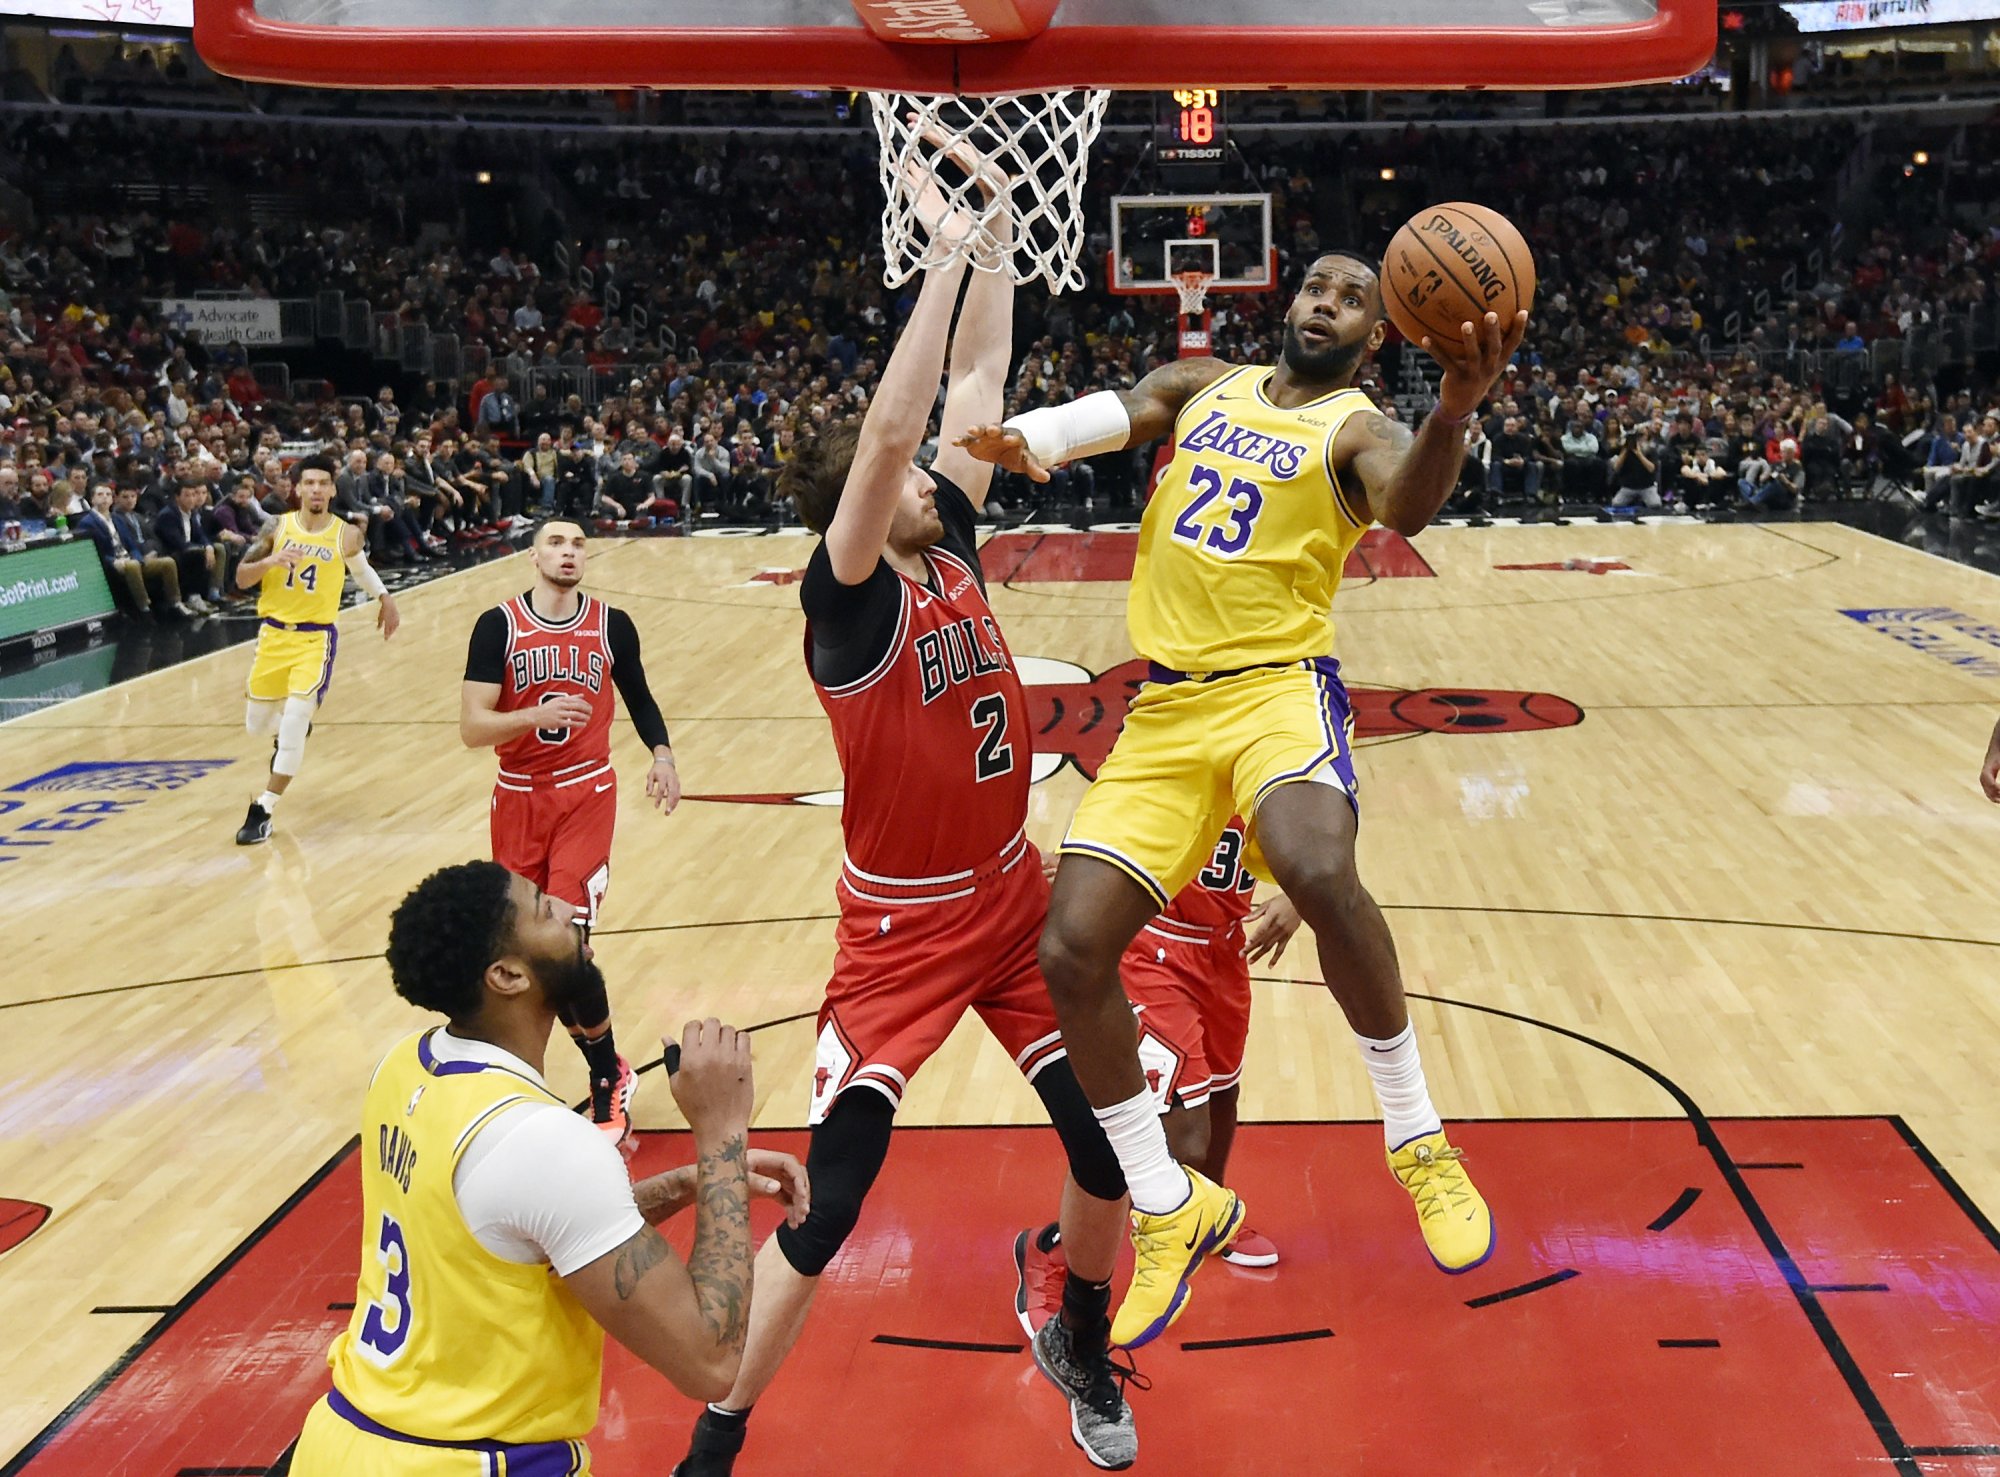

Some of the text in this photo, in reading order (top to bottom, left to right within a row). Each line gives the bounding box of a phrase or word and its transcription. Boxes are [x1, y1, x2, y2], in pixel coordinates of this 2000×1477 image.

[1173, 89, 1218, 109] 4:37
[1181, 108, 1213, 143] 18
[1177, 148, 1223, 159] TISSOT
[1421, 214, 1507, 302] SPALDING
[198, 306, 260, 322] Advocate
[245, 326, 276, 341] Care
[1178, 409, 1309, 481] LAKERS
[1171, 464, 1264, 557] 23
[285, 561, 318, 592] 14
[511, 645, 604, 695] BULLS
[970, 692, 1013, 783] 2
[379, 1123, 417, 1195] DAVIS
[357, 1210, 413, 1370] 3
